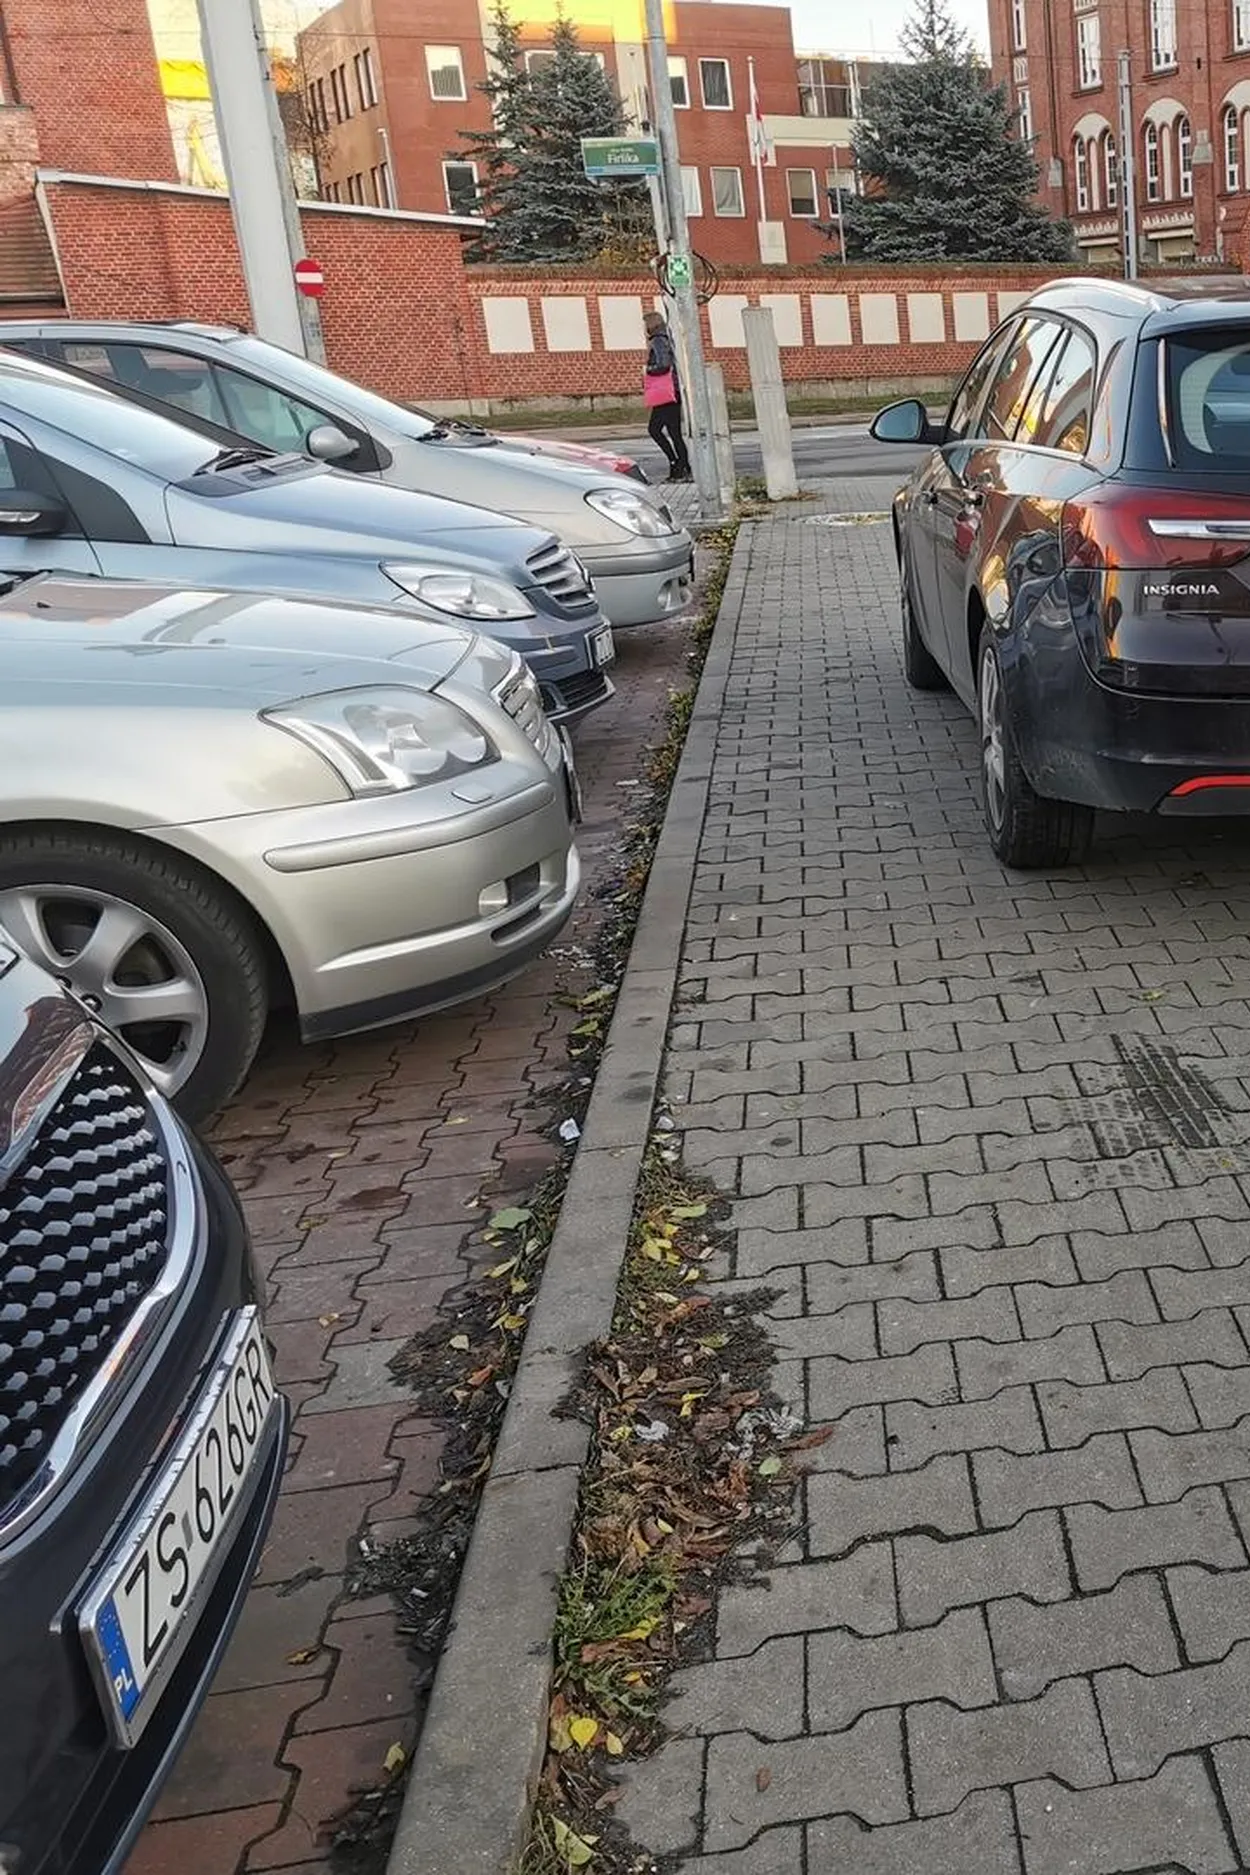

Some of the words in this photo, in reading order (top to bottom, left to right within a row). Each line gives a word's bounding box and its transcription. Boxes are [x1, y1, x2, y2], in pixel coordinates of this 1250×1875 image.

[1143, 584, 1220, 596] INSIGNIA
[125, 1512, 189, 1670] ZS
[195, 1337, 270, 1544] 626GR
[113, 1672, 134, 1703] PL
